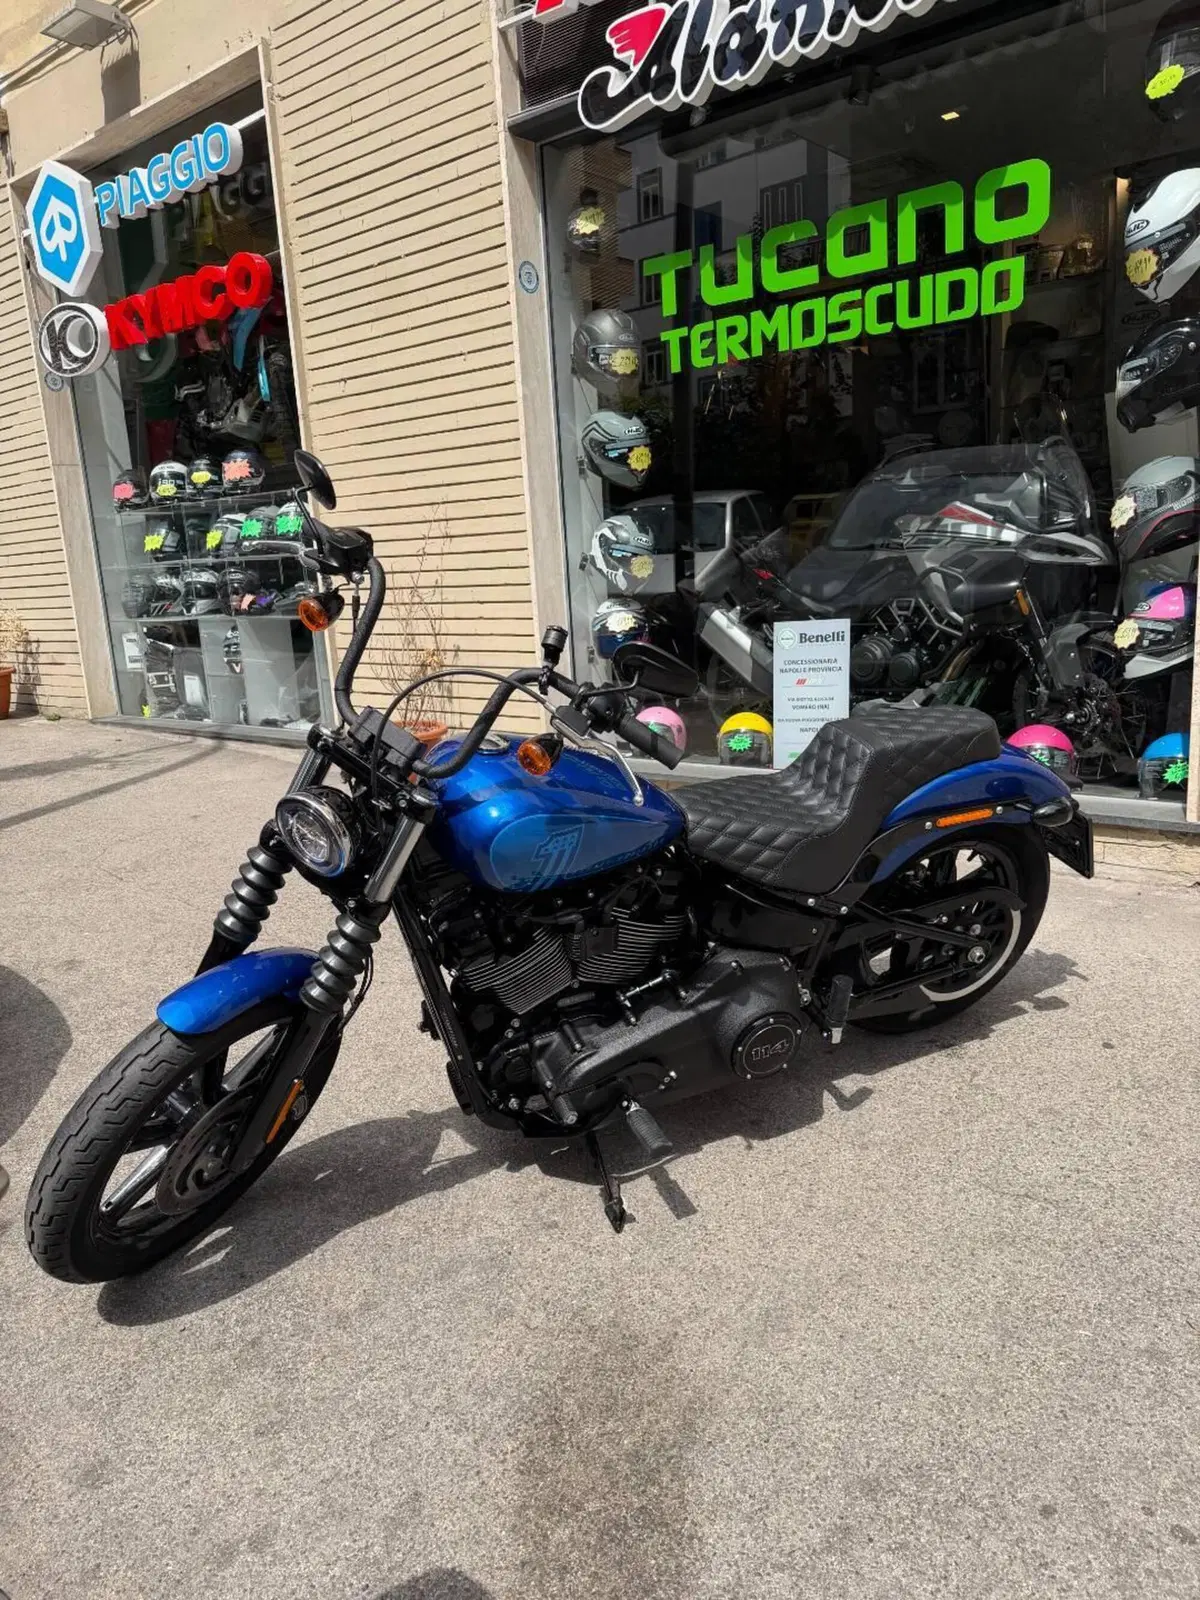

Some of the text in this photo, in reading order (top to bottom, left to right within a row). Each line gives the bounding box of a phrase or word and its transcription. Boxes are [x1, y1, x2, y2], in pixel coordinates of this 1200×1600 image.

[95, 122, 240, 226] PIAGGIO
[103, 252, 273, 350] KYMCO
[660, 256, 1026, 374] TERMOSCUDO
[783, 657, 838, 666] CONCESSIONARIA
[798, 630, 846, 644] Benelli
[751, 1038, 790, 1061] 114
